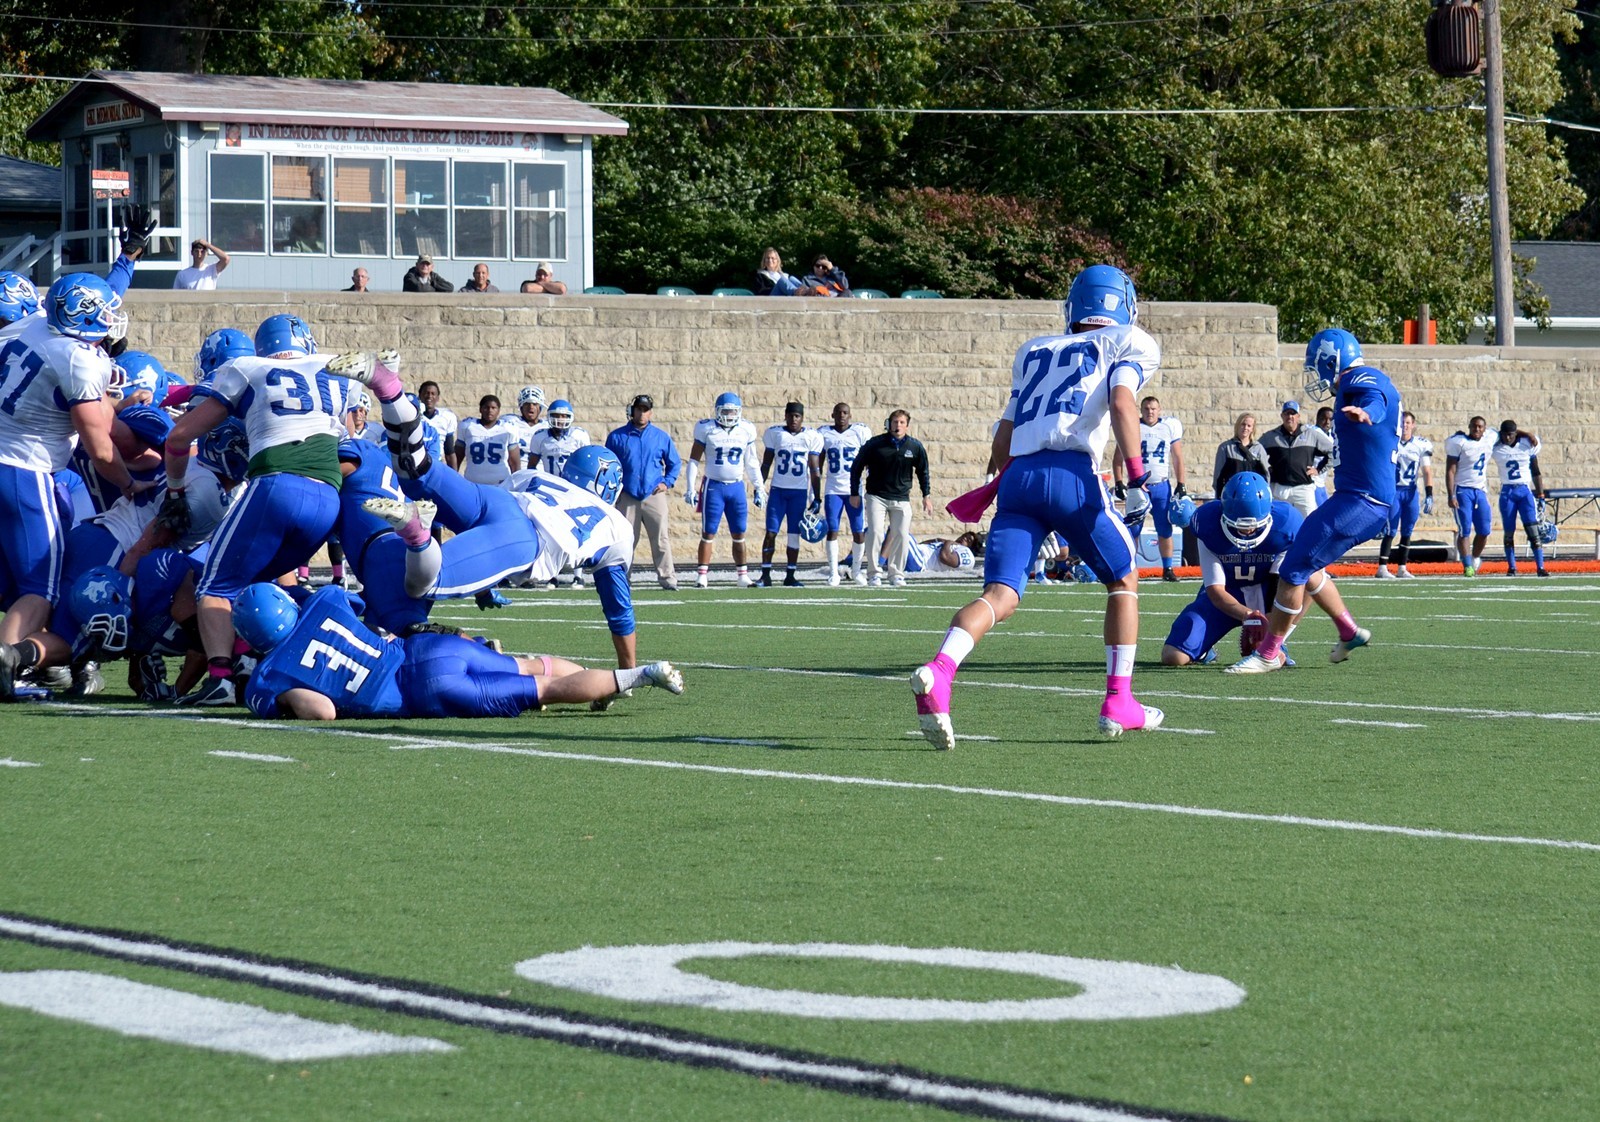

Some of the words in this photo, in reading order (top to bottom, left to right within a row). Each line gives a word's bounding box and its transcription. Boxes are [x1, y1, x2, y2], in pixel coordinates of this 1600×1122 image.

[248, 124, 264, 138] IN
[267, 124, 331, 140] MEMORY
[331, 126, 351, 141] OF
[354, 127, 410, 143] TANNER
[412, 128, 450, 143] MERZ
[454, 129, 514, 146] 1991-2013
[1087, 317, 1112, 325] Riddell
[266, 367, 349, 417] 30
[1014, 341, 1099, 429] 22
[470, 442, 503, 465] 85
[715, 446, 743, 465] 10
[777, 449, 806, 476] 35
[827, 447, 857, 474] 85
[1473, 453, 1485, 476] 4
[1505, 460, 1521, 480] 2
[1244, 553, 1276, 563] STATE
[1234, 566, 1256, 581] 4
[300, 617, 382, 694] 31
